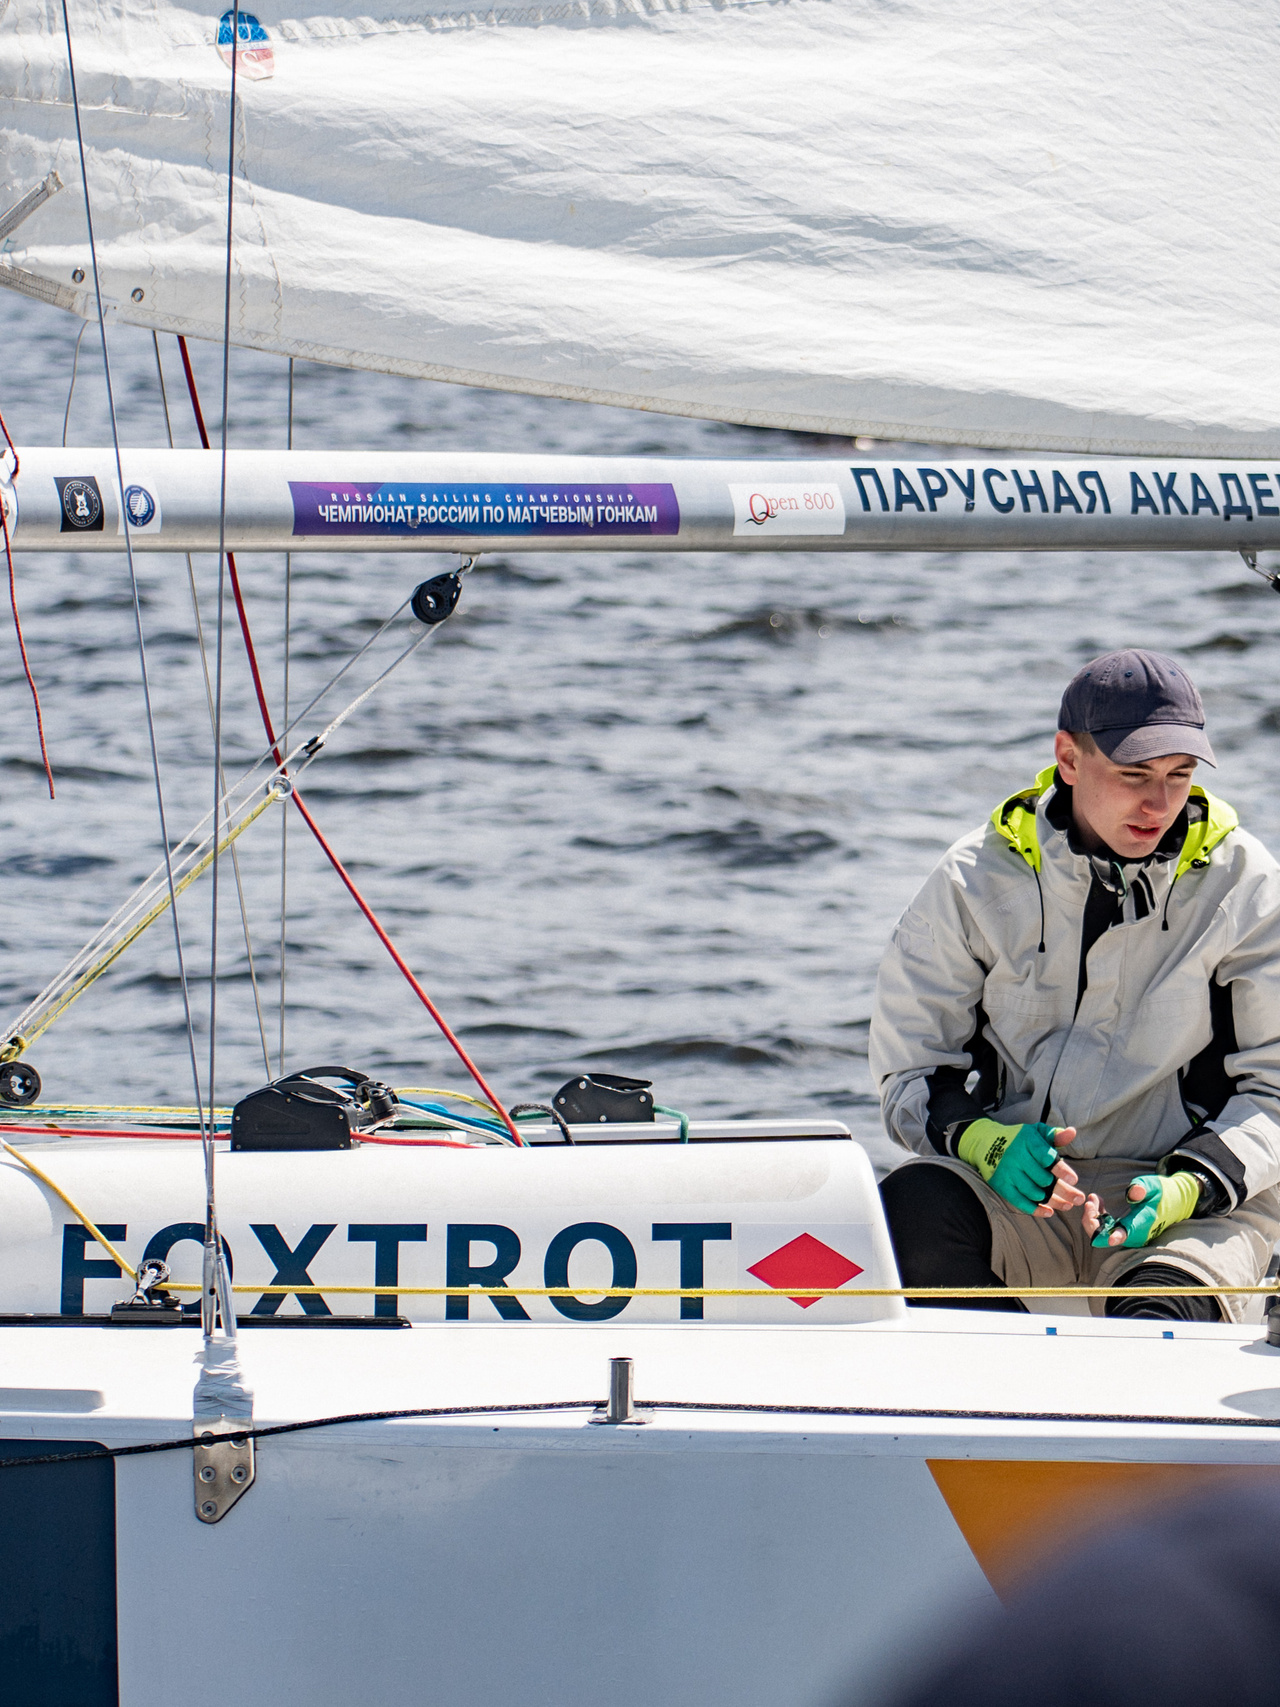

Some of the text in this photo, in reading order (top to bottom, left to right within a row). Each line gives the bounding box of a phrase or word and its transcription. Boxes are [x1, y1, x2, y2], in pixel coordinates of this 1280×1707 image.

[331, 493, 634, 503] RUSSIAN SAILING CHAMPIONSHIP
[850, 467, 1112, 514] ПАРУСНАЯ
[802, 492, 835, 510] 800
[318, 505, 658, 523] ЧЕМПИОНАТ РОССИИ ПО МАТЧЕВЫМ ГОНКАМ
[60, 1222, 732, 1321] FOXTROT
